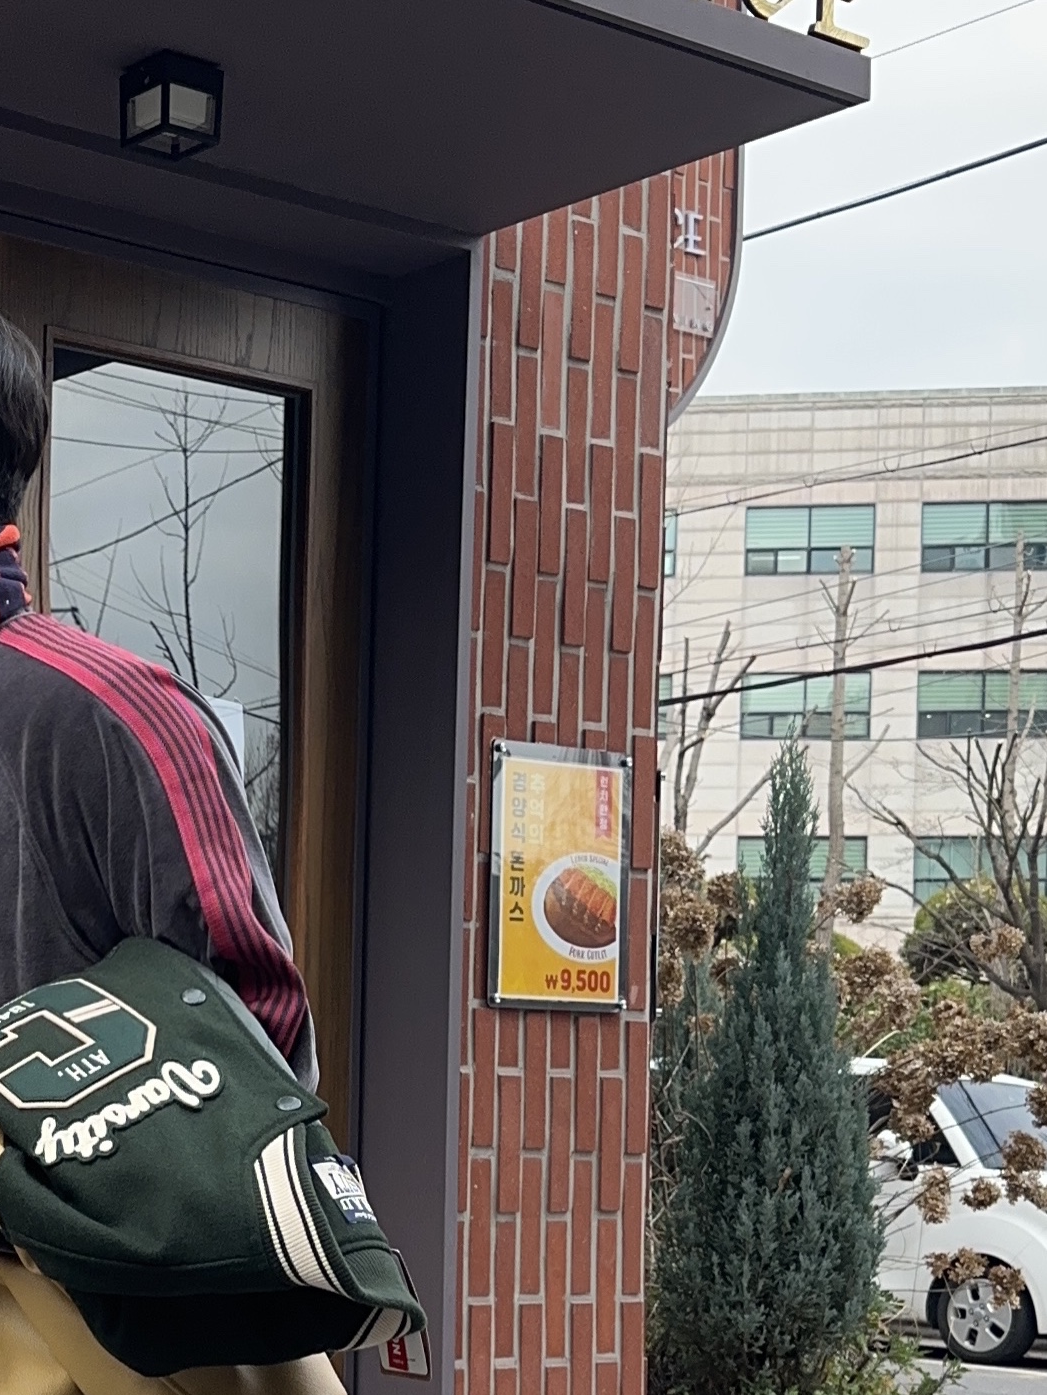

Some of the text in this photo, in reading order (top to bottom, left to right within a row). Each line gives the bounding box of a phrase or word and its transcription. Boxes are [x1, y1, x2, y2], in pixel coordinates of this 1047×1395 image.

[545, 968, 611, 994] ₩9,500
[57, 1048, 111, 1082] ATH.
[34, 1059, 221, 1164] Varsity
